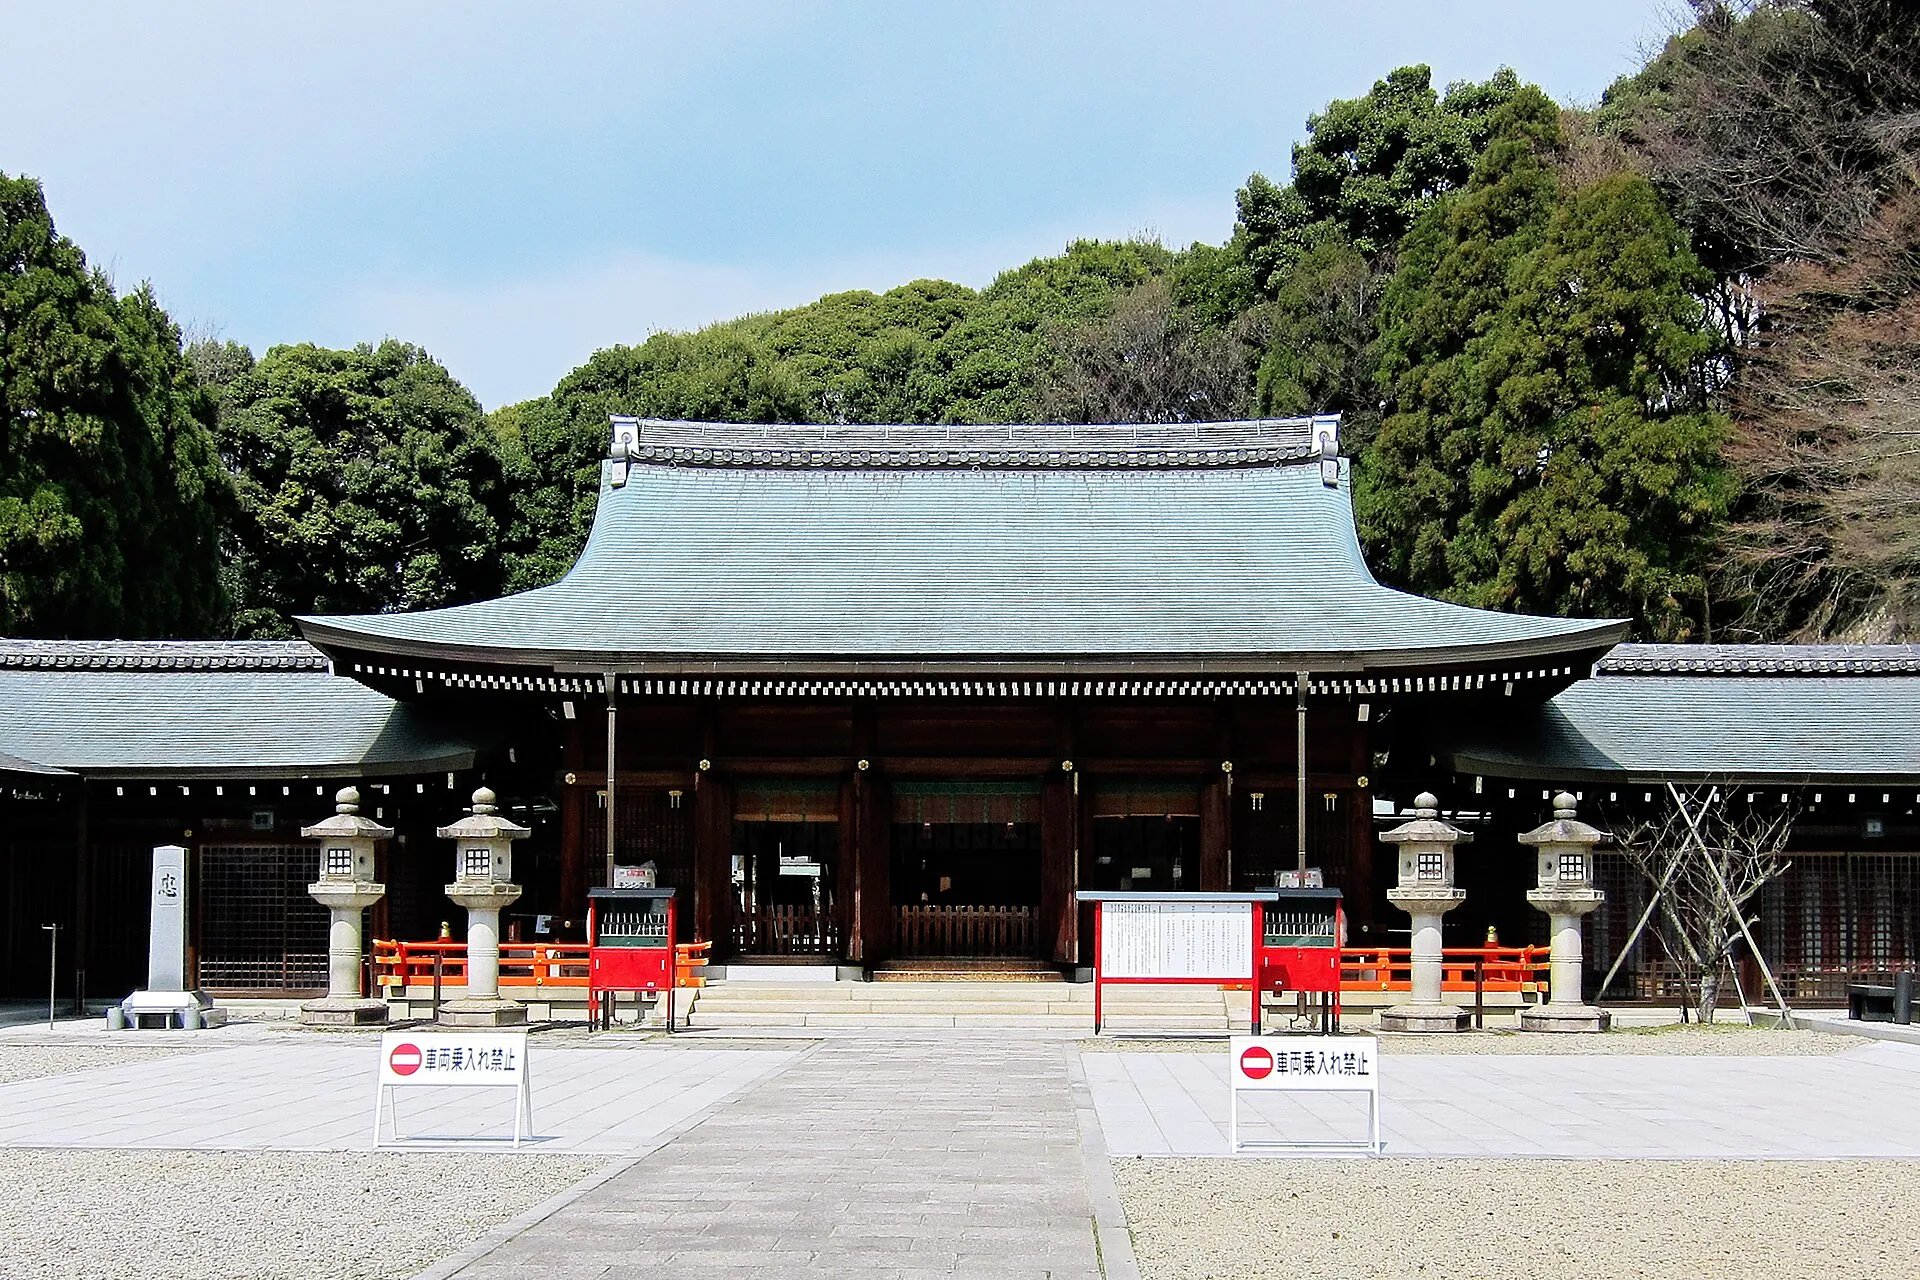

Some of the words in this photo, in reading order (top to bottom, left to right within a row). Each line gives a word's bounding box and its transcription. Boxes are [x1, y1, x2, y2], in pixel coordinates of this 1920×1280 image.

[425, 1047, 516, 1072] 車両乗入れ禁止
[1276, 1050, 1370, 1076] 車両乗入れ禁止
